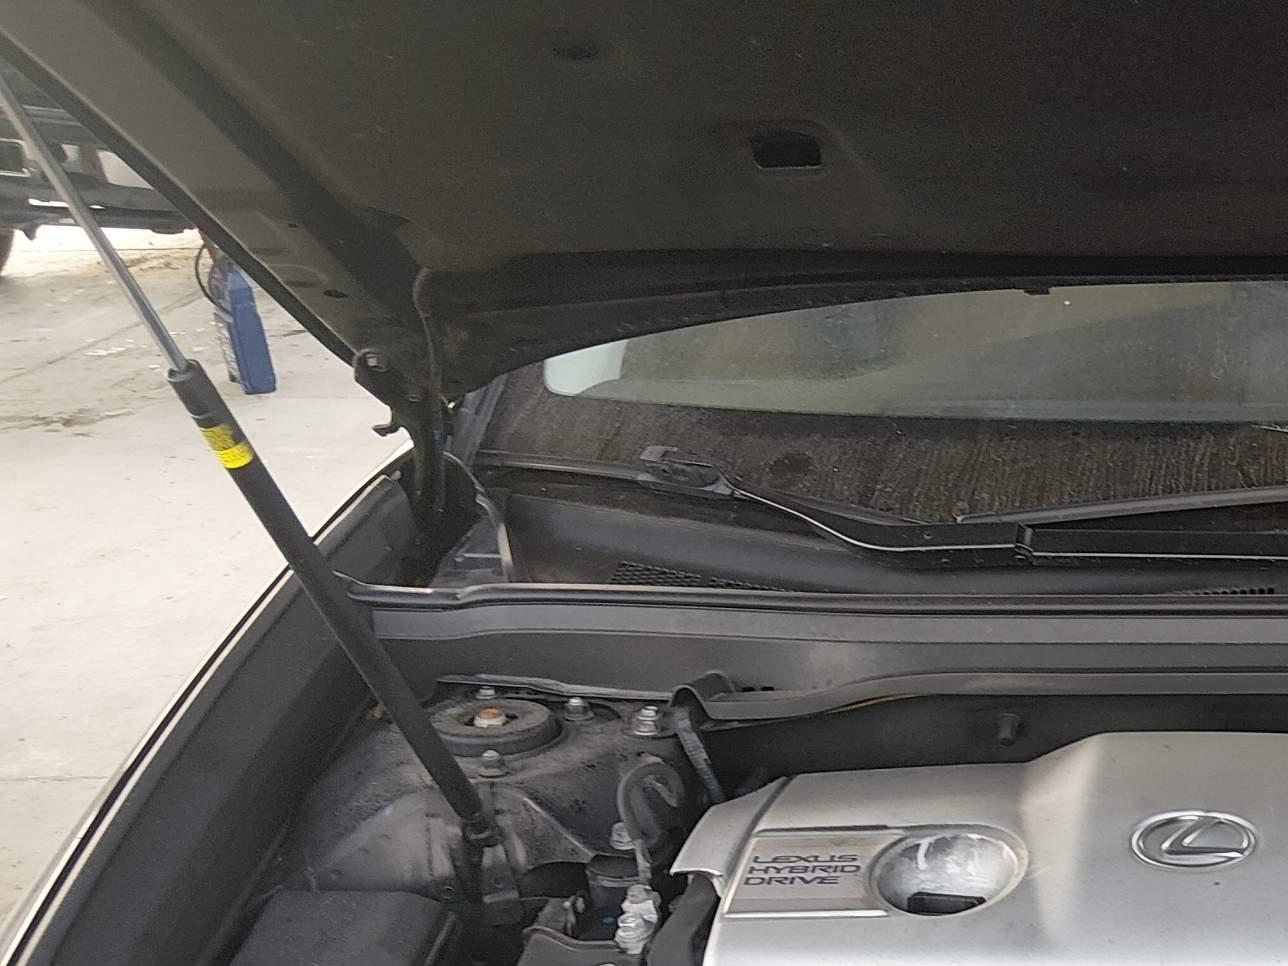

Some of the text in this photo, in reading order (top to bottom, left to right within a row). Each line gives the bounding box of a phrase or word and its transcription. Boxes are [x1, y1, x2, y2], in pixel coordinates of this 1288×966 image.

[752, 854, 860, 864] LEXUS
[748, 864, 861, 874] HYBRID
[743, 875, 841, 886] DRIVE
